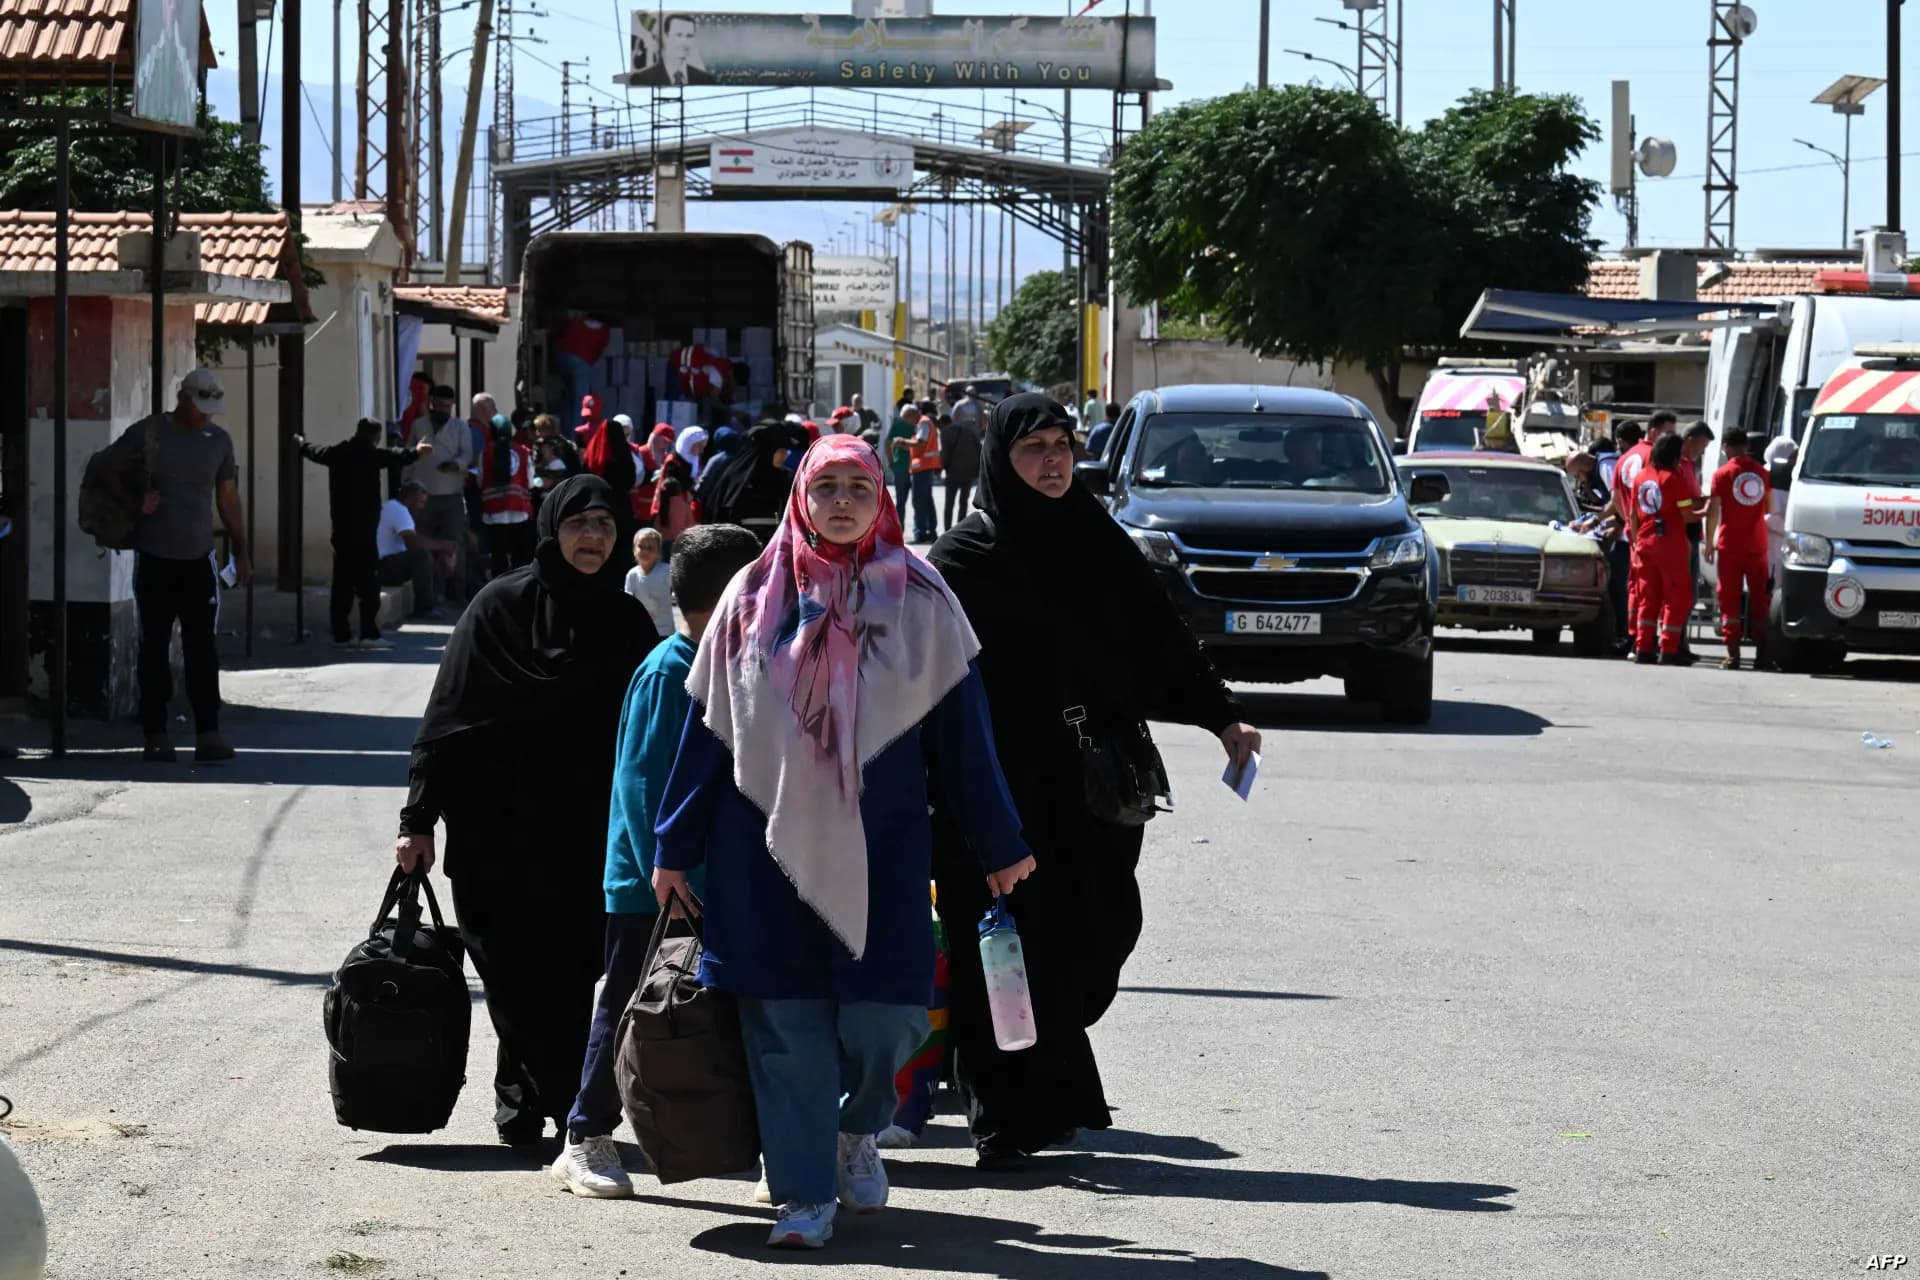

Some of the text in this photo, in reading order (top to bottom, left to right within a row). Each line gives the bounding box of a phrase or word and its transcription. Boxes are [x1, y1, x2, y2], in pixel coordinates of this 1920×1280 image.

[840, 60, 1092, 83] Safety With You
[1237, 614, 1311, 631] G 642477
